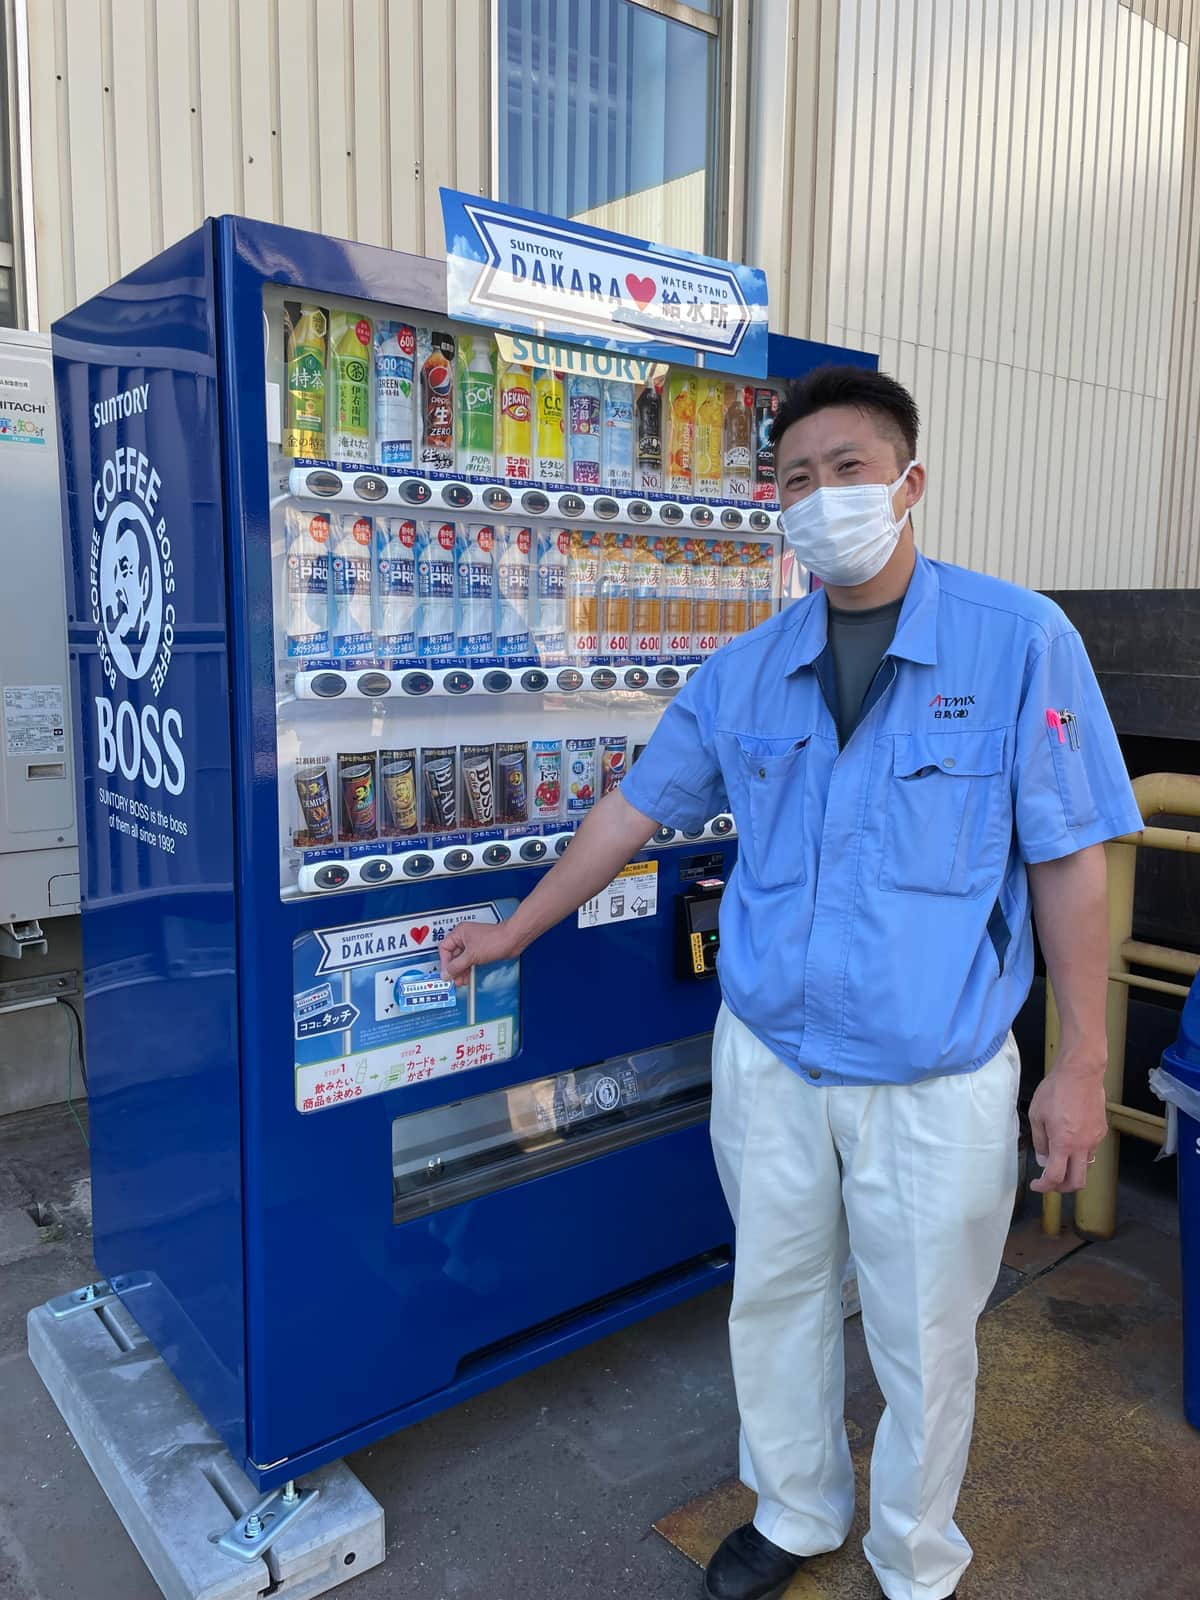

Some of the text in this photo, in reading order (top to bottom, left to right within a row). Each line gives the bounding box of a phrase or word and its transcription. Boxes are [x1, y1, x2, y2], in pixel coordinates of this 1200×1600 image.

[510, 238, 564, 261] SUNTORY
[511, 253, 623, 307] DAKARA
[661, 275, 728, 299] WATER STAND
[661, 289, 729, 329] 給水所
[400, 336, 415, 348] 600
[291, 366, 324, 390] 特茶
[94, 383, 150, 429] SUNTORY
[94, 446, 162, 521] COFFEE
[300, 567, 328, 579] PRO
[90, 527, 117, 691] BOSS COFFEE
[150, 516, 176, 698] BOSS COFFEE
[928, 694, 976, 708] ATMIX
[95, 696, 186, 796] BOSS
[476, 767, 493, 820] BOSS
[99, 787, 188, 836] SUNTORY BOSS is the boss
[109, 813, 115, 828] of
[116, 816, 131, 835] them
[139, 826, 157, 846] since
[158, 833, 176, 854] 1992
[433, 914, 477, 926] WATER STAND
[342, 932, 374, 943] SUNTORY
[342, 934, 409, 959] DAKARA
[299, 1009, 352, 1031] ココにタッチ
[450, 1052, 495, 1071] ボタンを押す
[455, 1042, 492, 1060] 5秒内に
[406, 1056, 436, 1072] カードを
[407, 1067, 434, 1083] かざす
[303, 1085, 363, 1111] 商品を決める
[315, 1077, 354, 1095] 飲みたい
